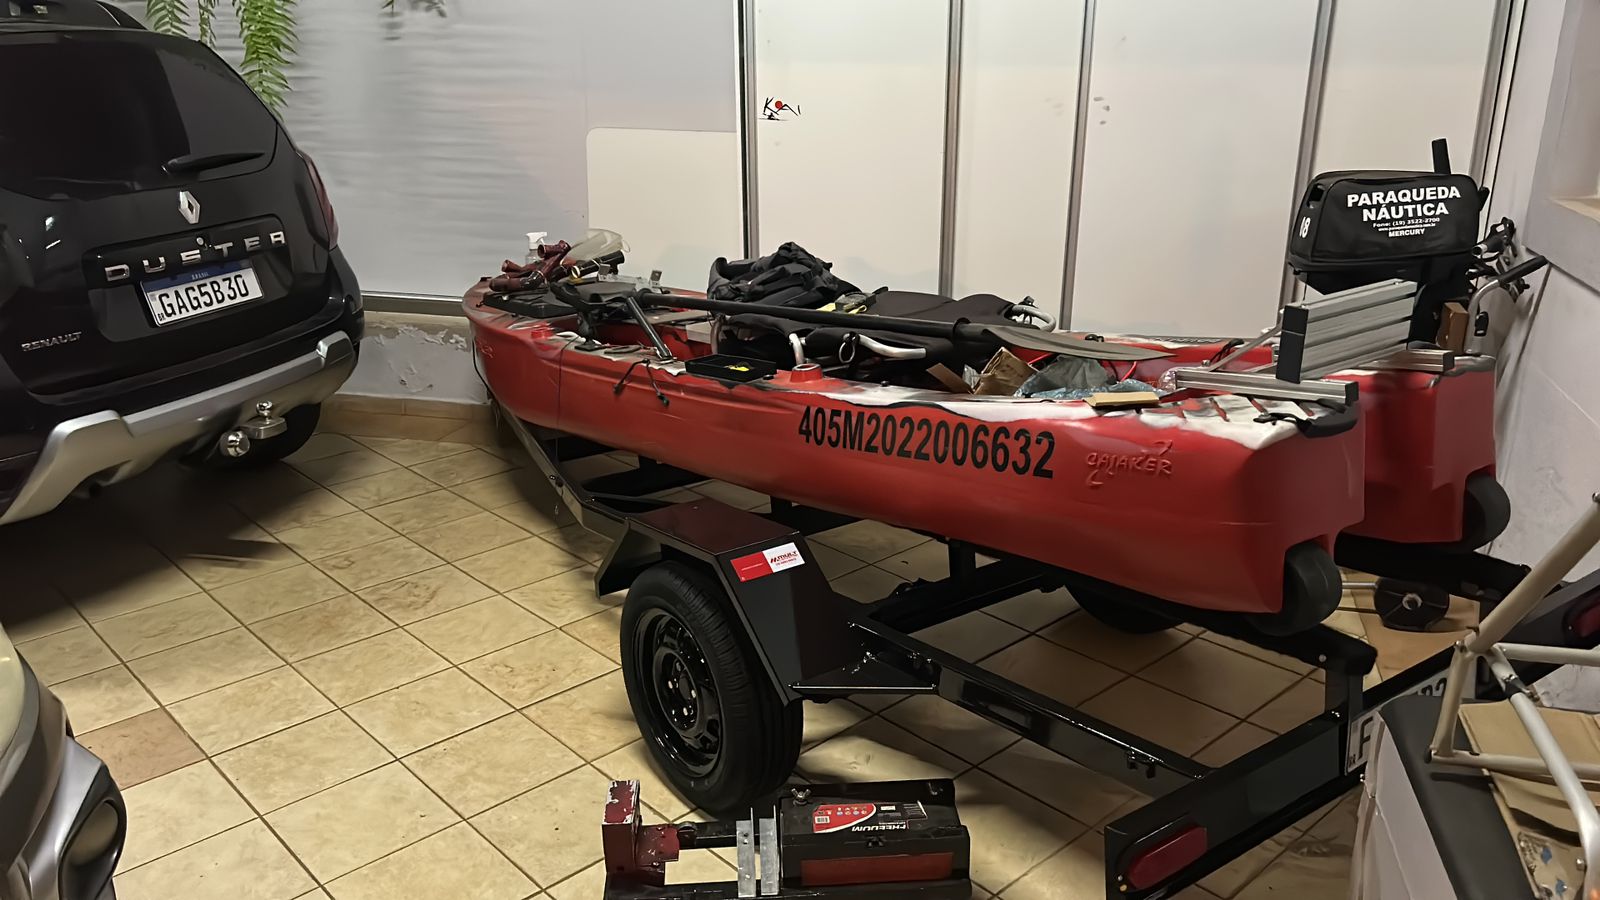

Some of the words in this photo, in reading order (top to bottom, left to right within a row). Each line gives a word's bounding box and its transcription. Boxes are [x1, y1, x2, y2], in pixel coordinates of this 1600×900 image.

[1347, 187, 1460, 207] PARAQUEDA
[1362, 203, 1449, 221] NÁUTICA
[1388, 228, 1425, 237] MERCURY
[105, 231, 287, 281] DUSTER
[158, 274, 249, 318] GAG5B30
[21, 331, 82, 352] RENAULT
[799, 406, 1055, 479] 405M2022006632
